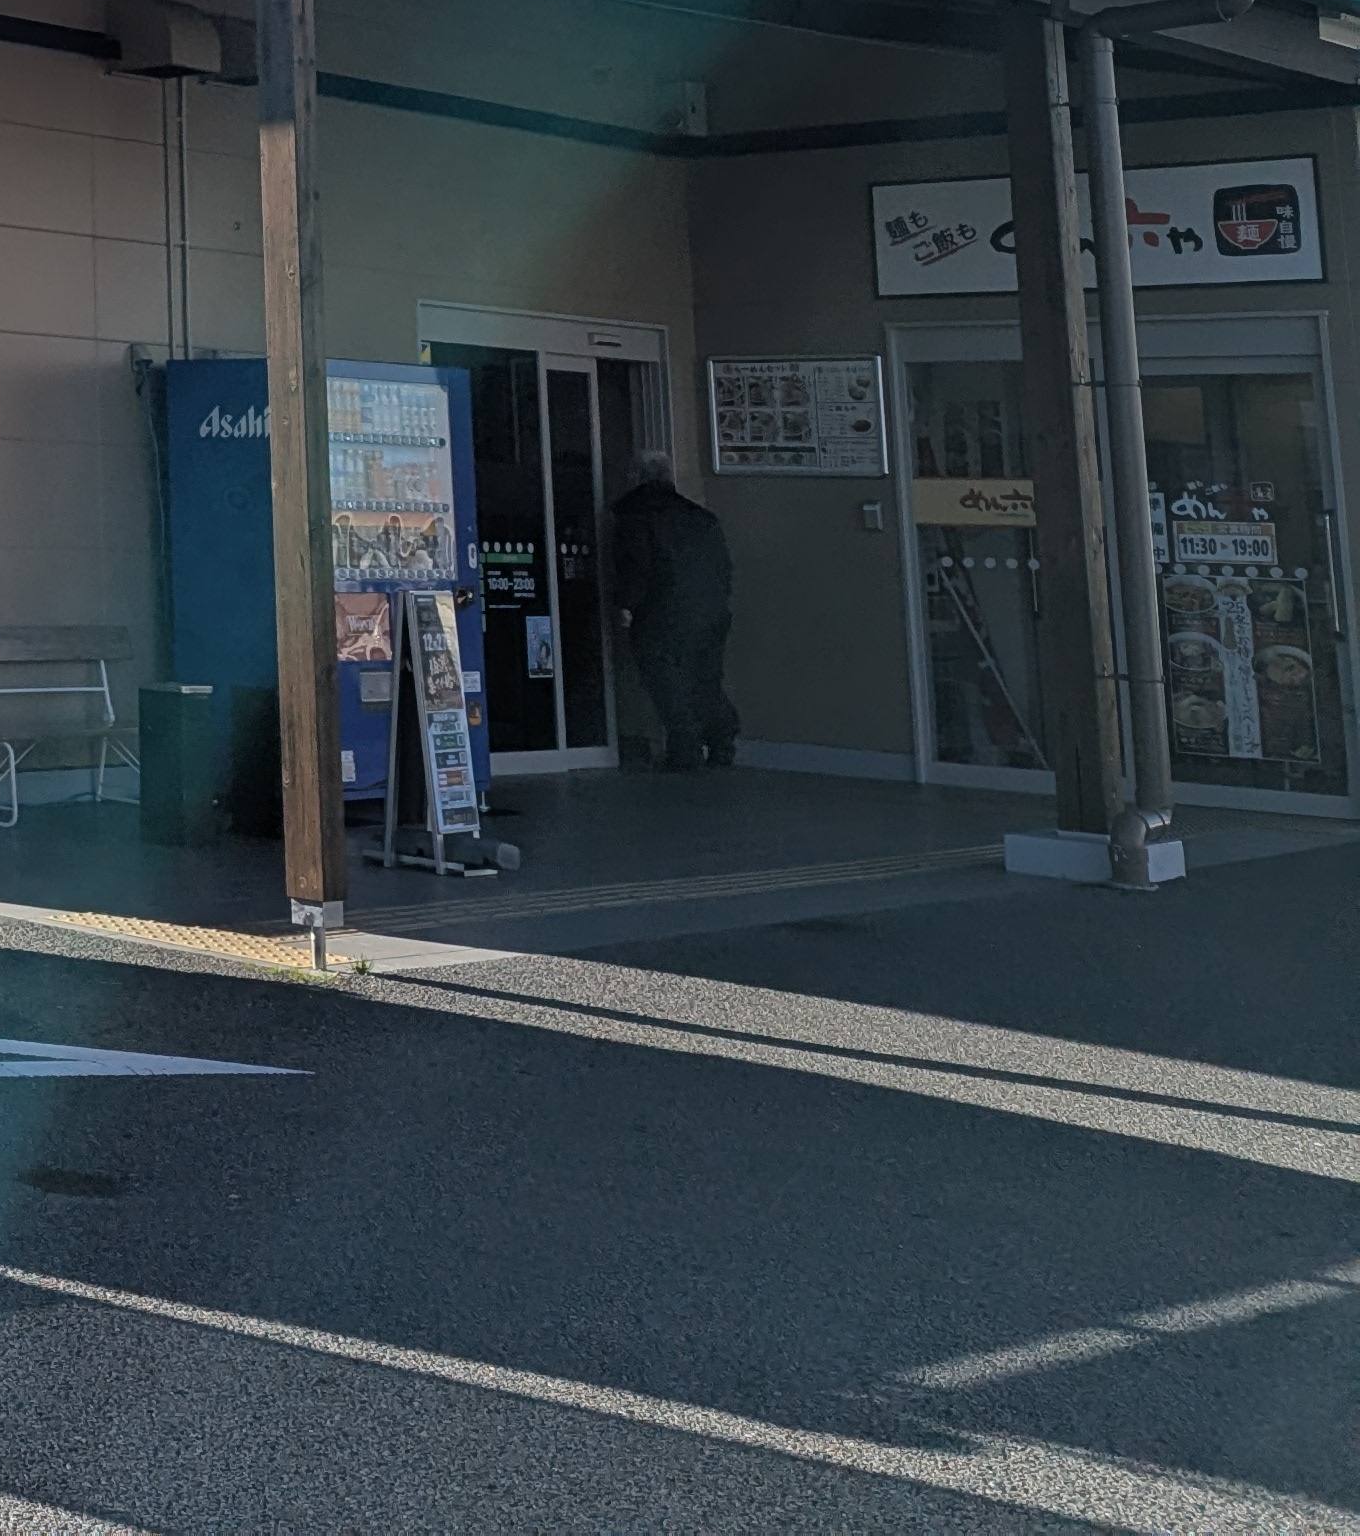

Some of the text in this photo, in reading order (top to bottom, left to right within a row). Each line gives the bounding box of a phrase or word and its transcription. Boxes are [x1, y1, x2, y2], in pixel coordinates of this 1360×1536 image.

[913, 223, 977, 261] ご飯も
[1275, 204, 1298, 249] 味自慢
[199, 405, 272, 438] Asahi
[959, 488, 1036, 513] めん六
[1180, 537, 1270, 557] 11:30 19:00
